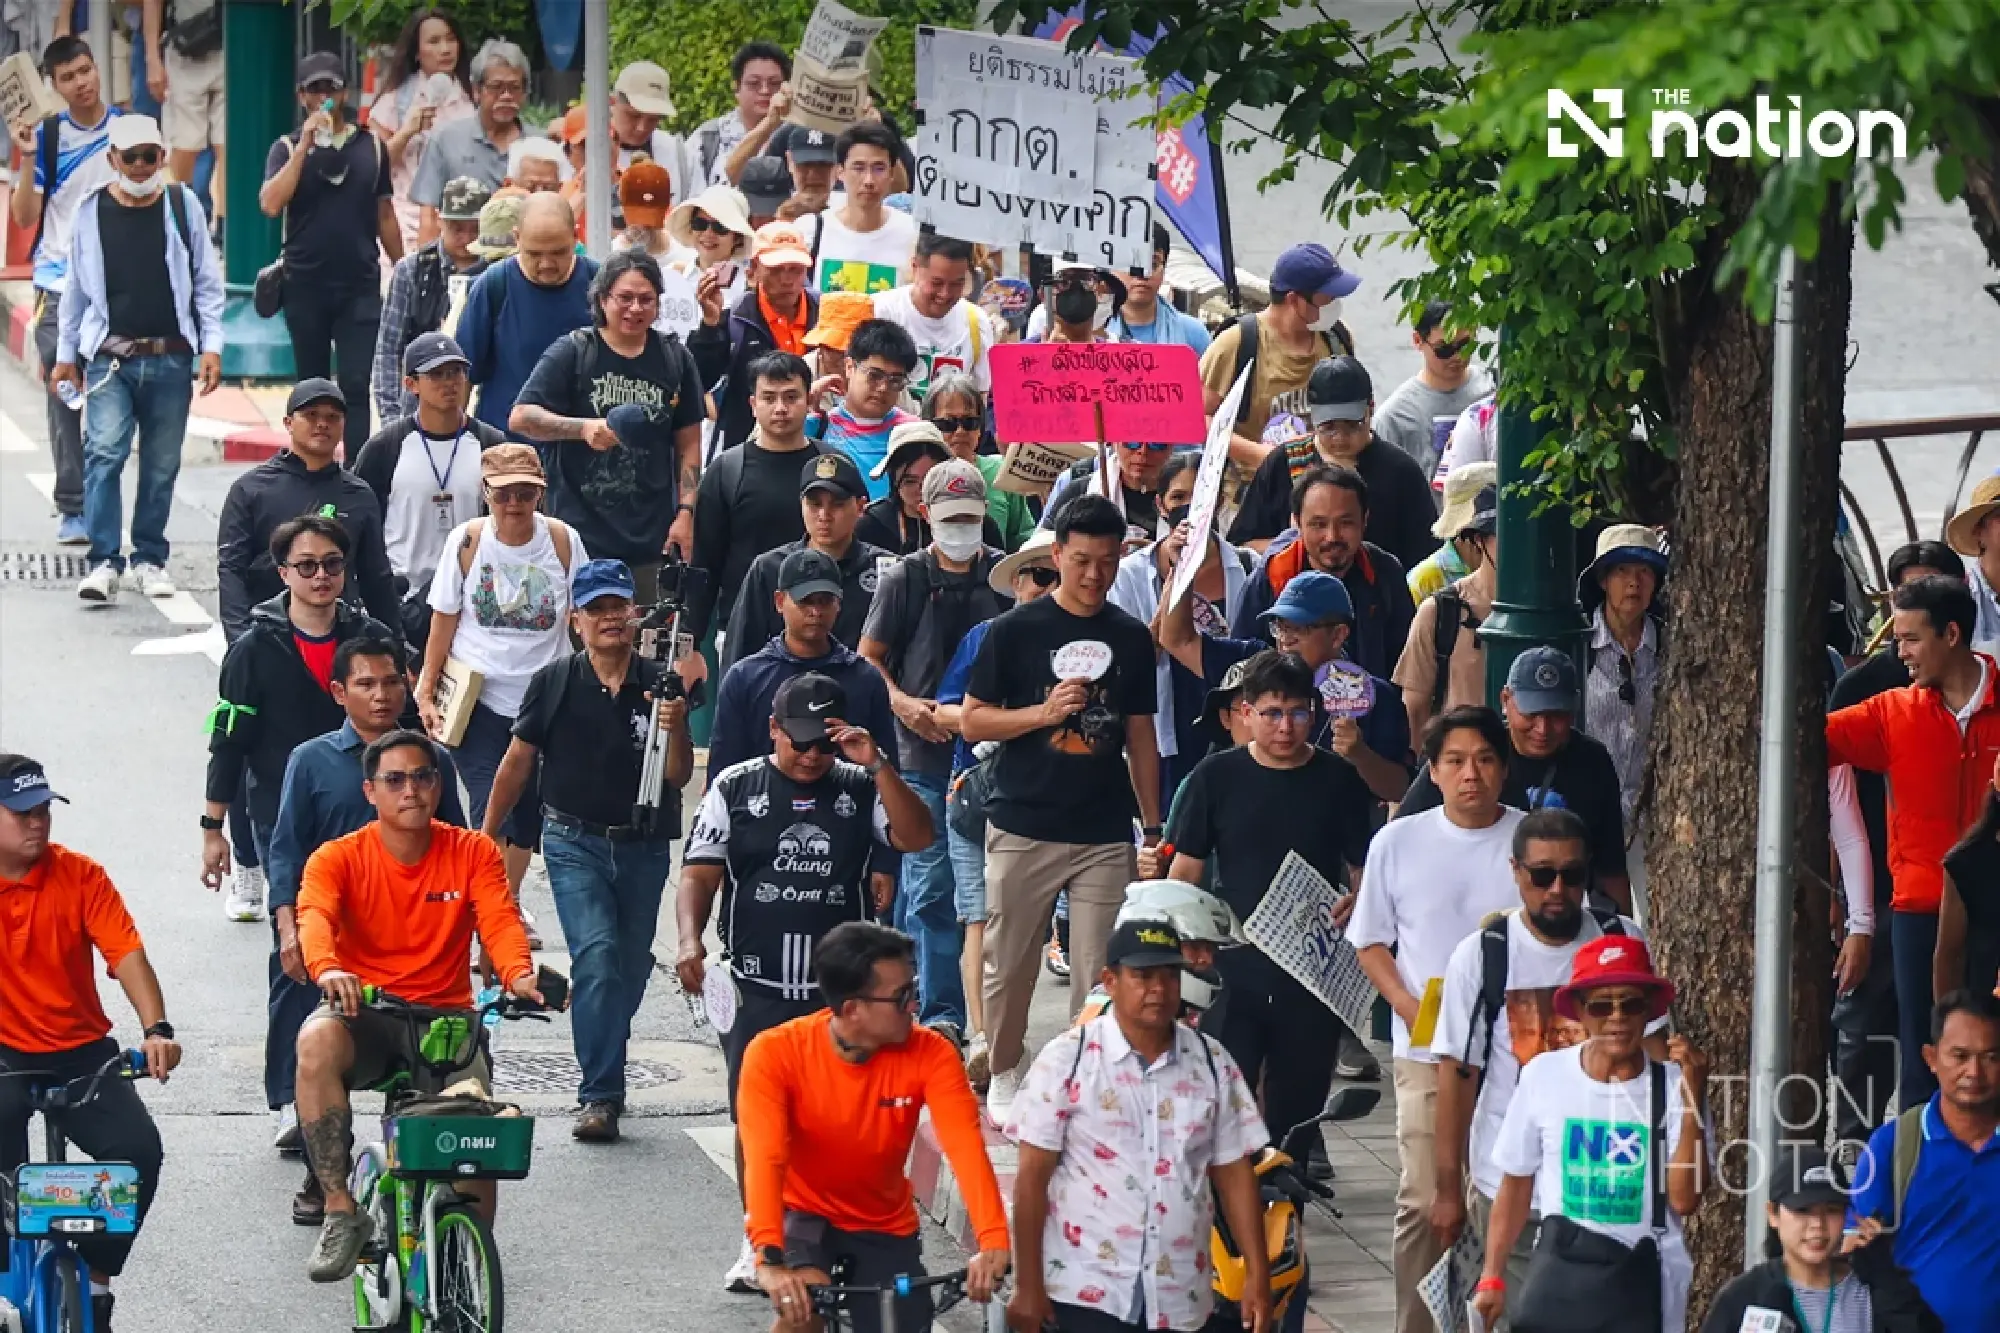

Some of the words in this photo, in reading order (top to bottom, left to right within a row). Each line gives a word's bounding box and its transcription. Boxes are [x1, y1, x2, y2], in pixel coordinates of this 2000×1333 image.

[947, 109, 1077, 179] กกต.
[772, 854, 834, 877] Chang
[460, 1135, 497, 1150] กทม
